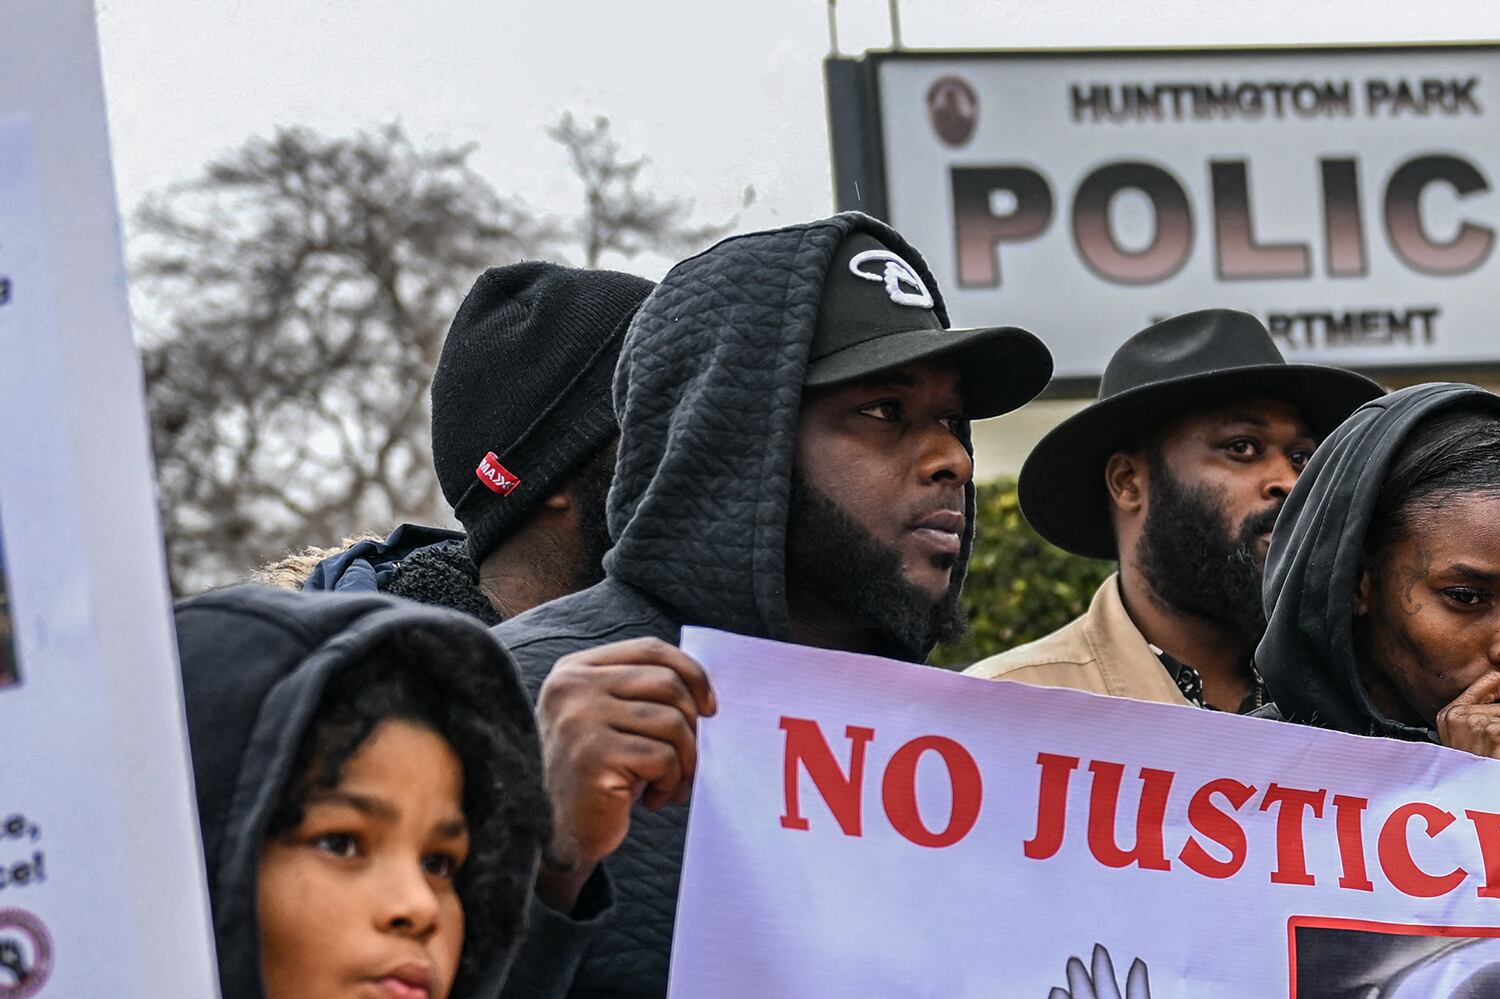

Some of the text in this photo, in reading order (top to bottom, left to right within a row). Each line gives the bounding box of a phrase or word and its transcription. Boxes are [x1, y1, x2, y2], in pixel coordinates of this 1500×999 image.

[1070, 77, 1483, 123] HUNTINGTON PARK
[1150, 304, 1441, 350] RTMENT
[779, 716, 984, 849] NO
